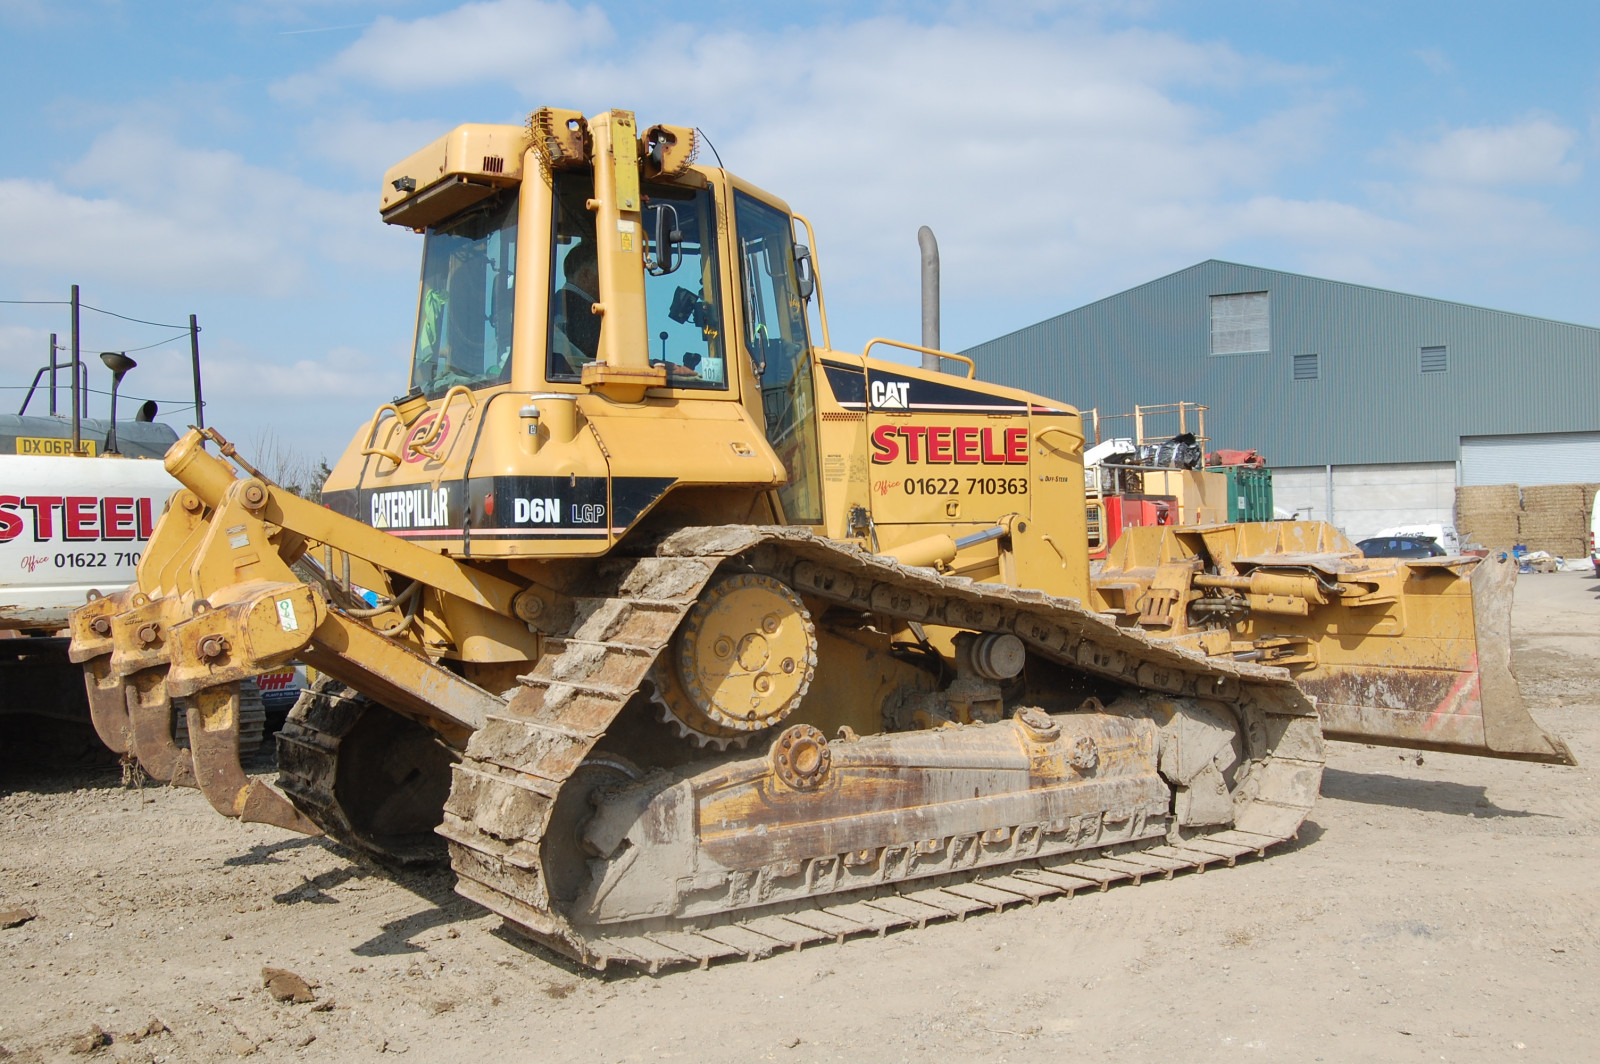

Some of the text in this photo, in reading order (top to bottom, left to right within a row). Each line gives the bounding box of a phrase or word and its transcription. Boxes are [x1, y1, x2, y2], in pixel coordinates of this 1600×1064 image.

[871, 381, 910, 408] CAT
[871, 425, 1029, 465] STEELE
[873, 478, 1028, 496] Office 01622 710363
[371, 487, 449, 529] CATERPILLAR
[514, 498, 605, 524] D6N LGP
[20, 554, 49, 573] Office
[54, 553, 107, 568] 01622
